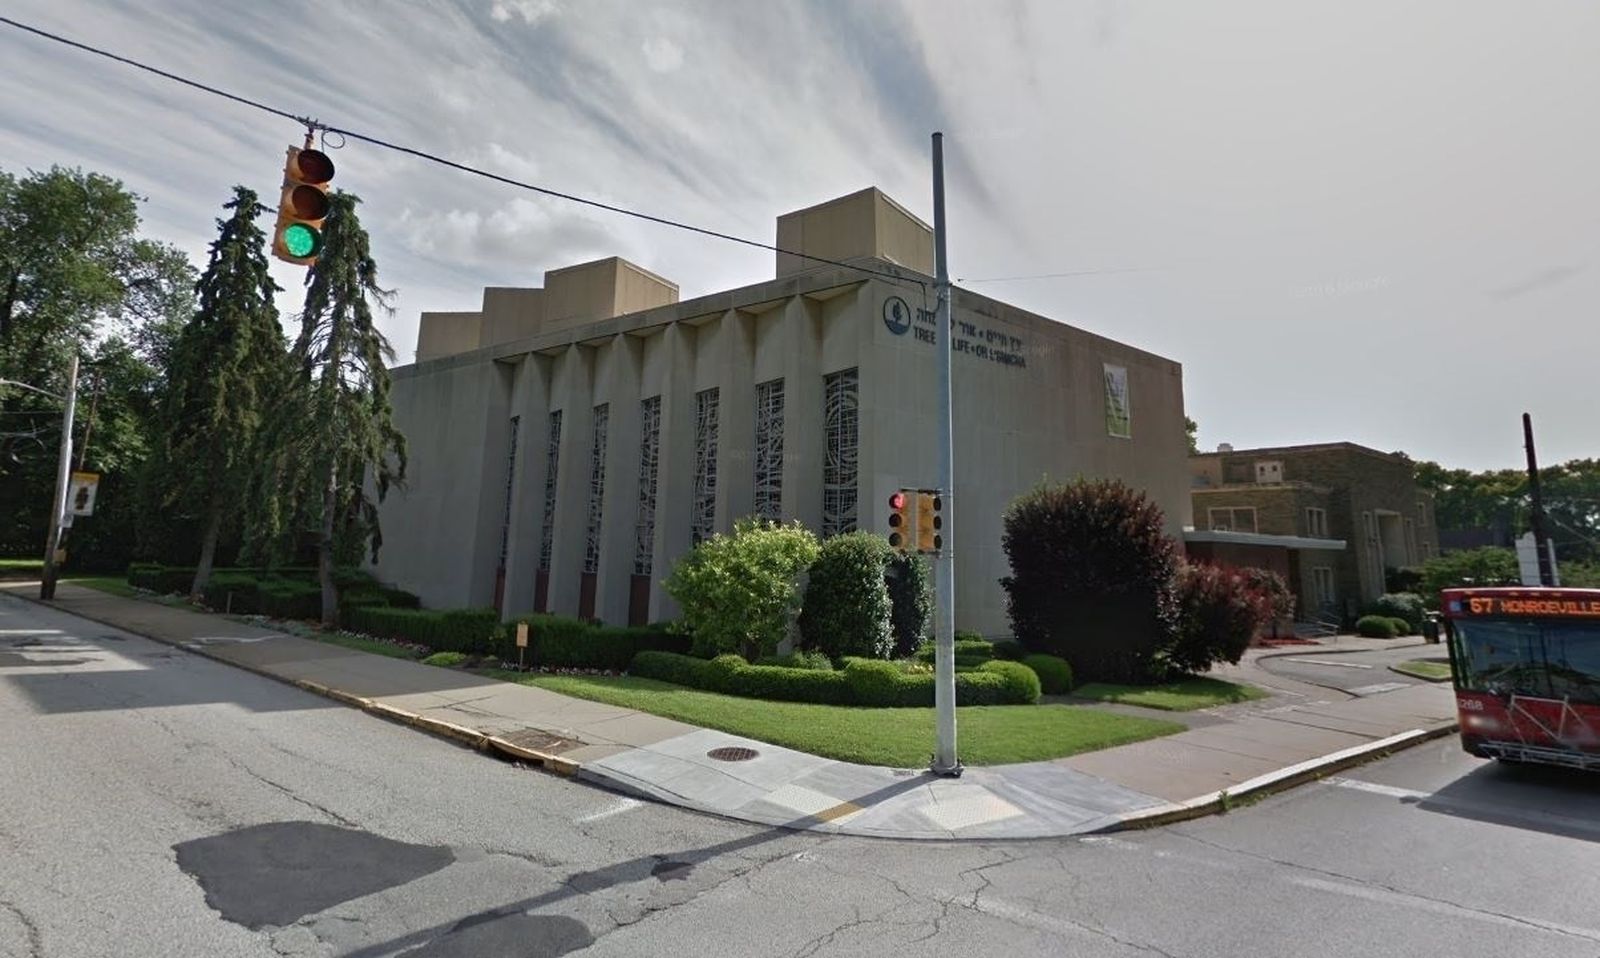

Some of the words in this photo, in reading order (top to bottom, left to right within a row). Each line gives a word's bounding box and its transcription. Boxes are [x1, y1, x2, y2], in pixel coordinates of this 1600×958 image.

[913, 326, 936, 345] TREE
[952, 338, 970, 354] LIFE
[1470, 597, 1493, 614] 67
[1500, 599, 1600, 615] MONROEVILLE
